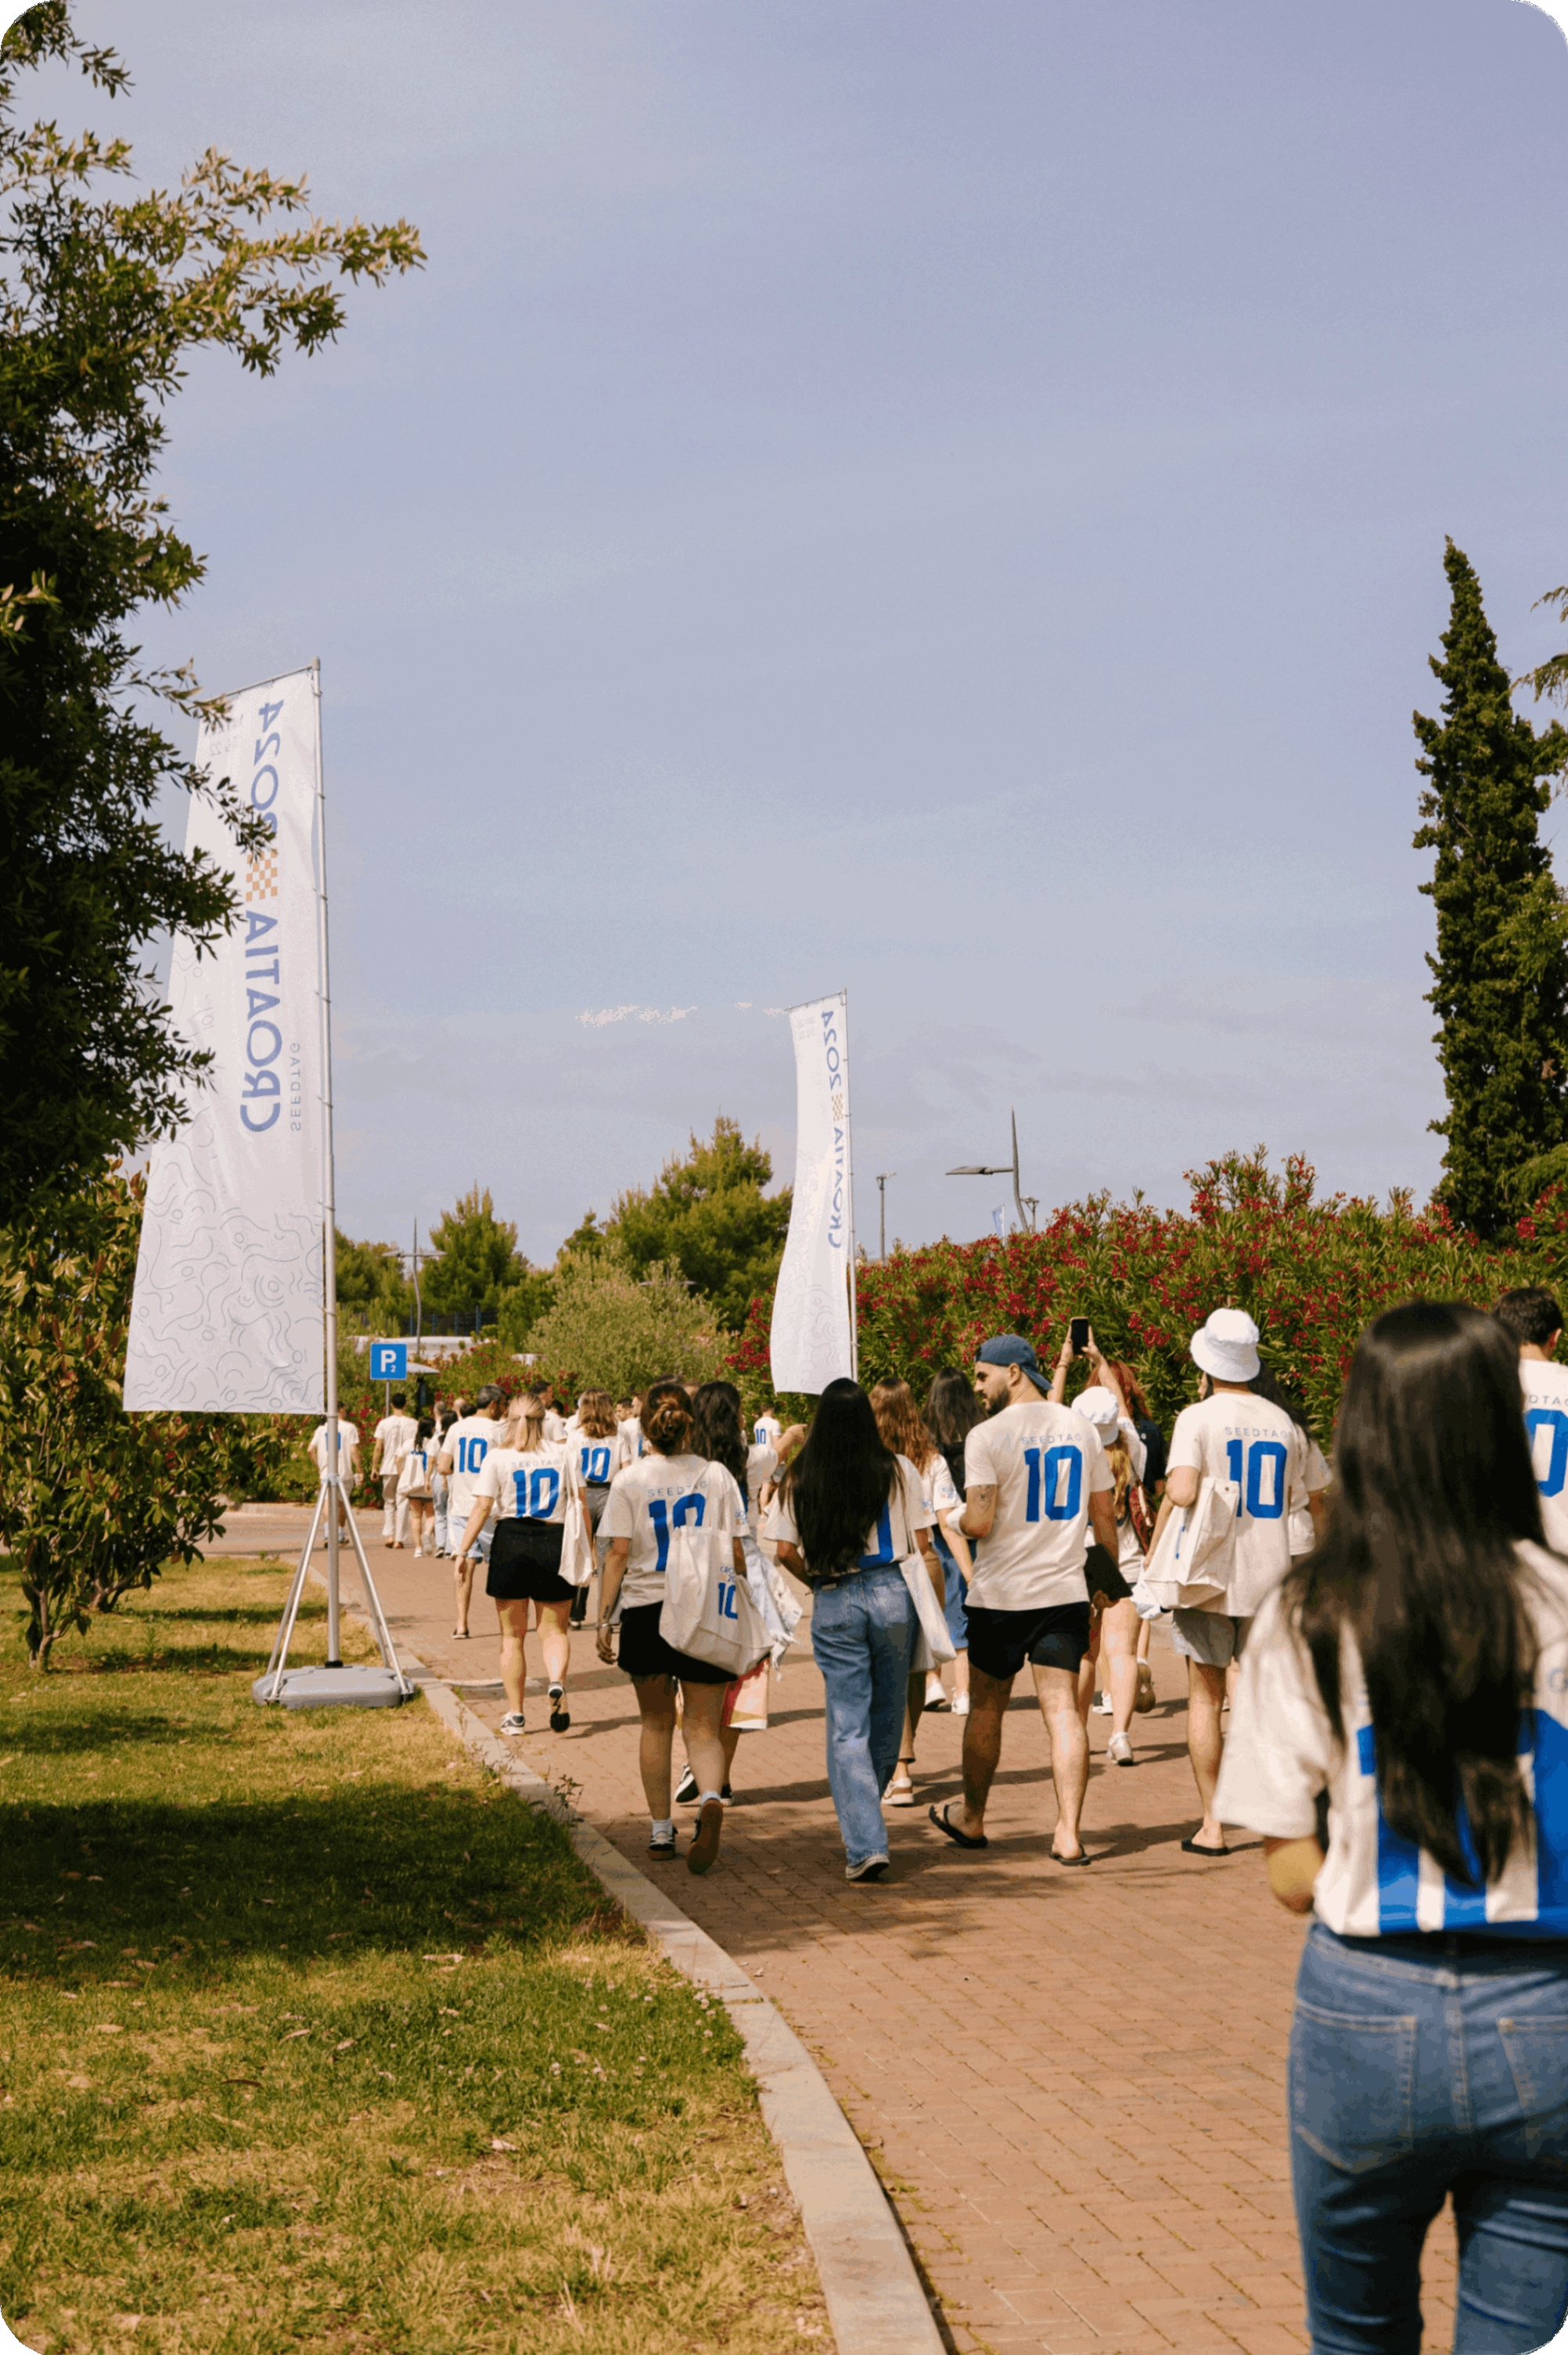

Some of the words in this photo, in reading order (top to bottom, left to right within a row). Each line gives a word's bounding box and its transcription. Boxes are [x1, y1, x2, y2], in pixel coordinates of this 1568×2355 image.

[756, 1428, 767, 1445] 10
[1020, 1433, 1083, 1446] SEEDTAG
[1225, 1426, 1289, 1439] SEEDTAG
[459, 1437, 488, 1474] 10
[512, 1459, 560, 1468] SEEDTAG
[581, 1446, 611, 1483] 10
[512, 1467, 560, 1518] 10
[1023, 1445, 1083, 1523] 10
[1226, 1439, 1288, 1519] 10
